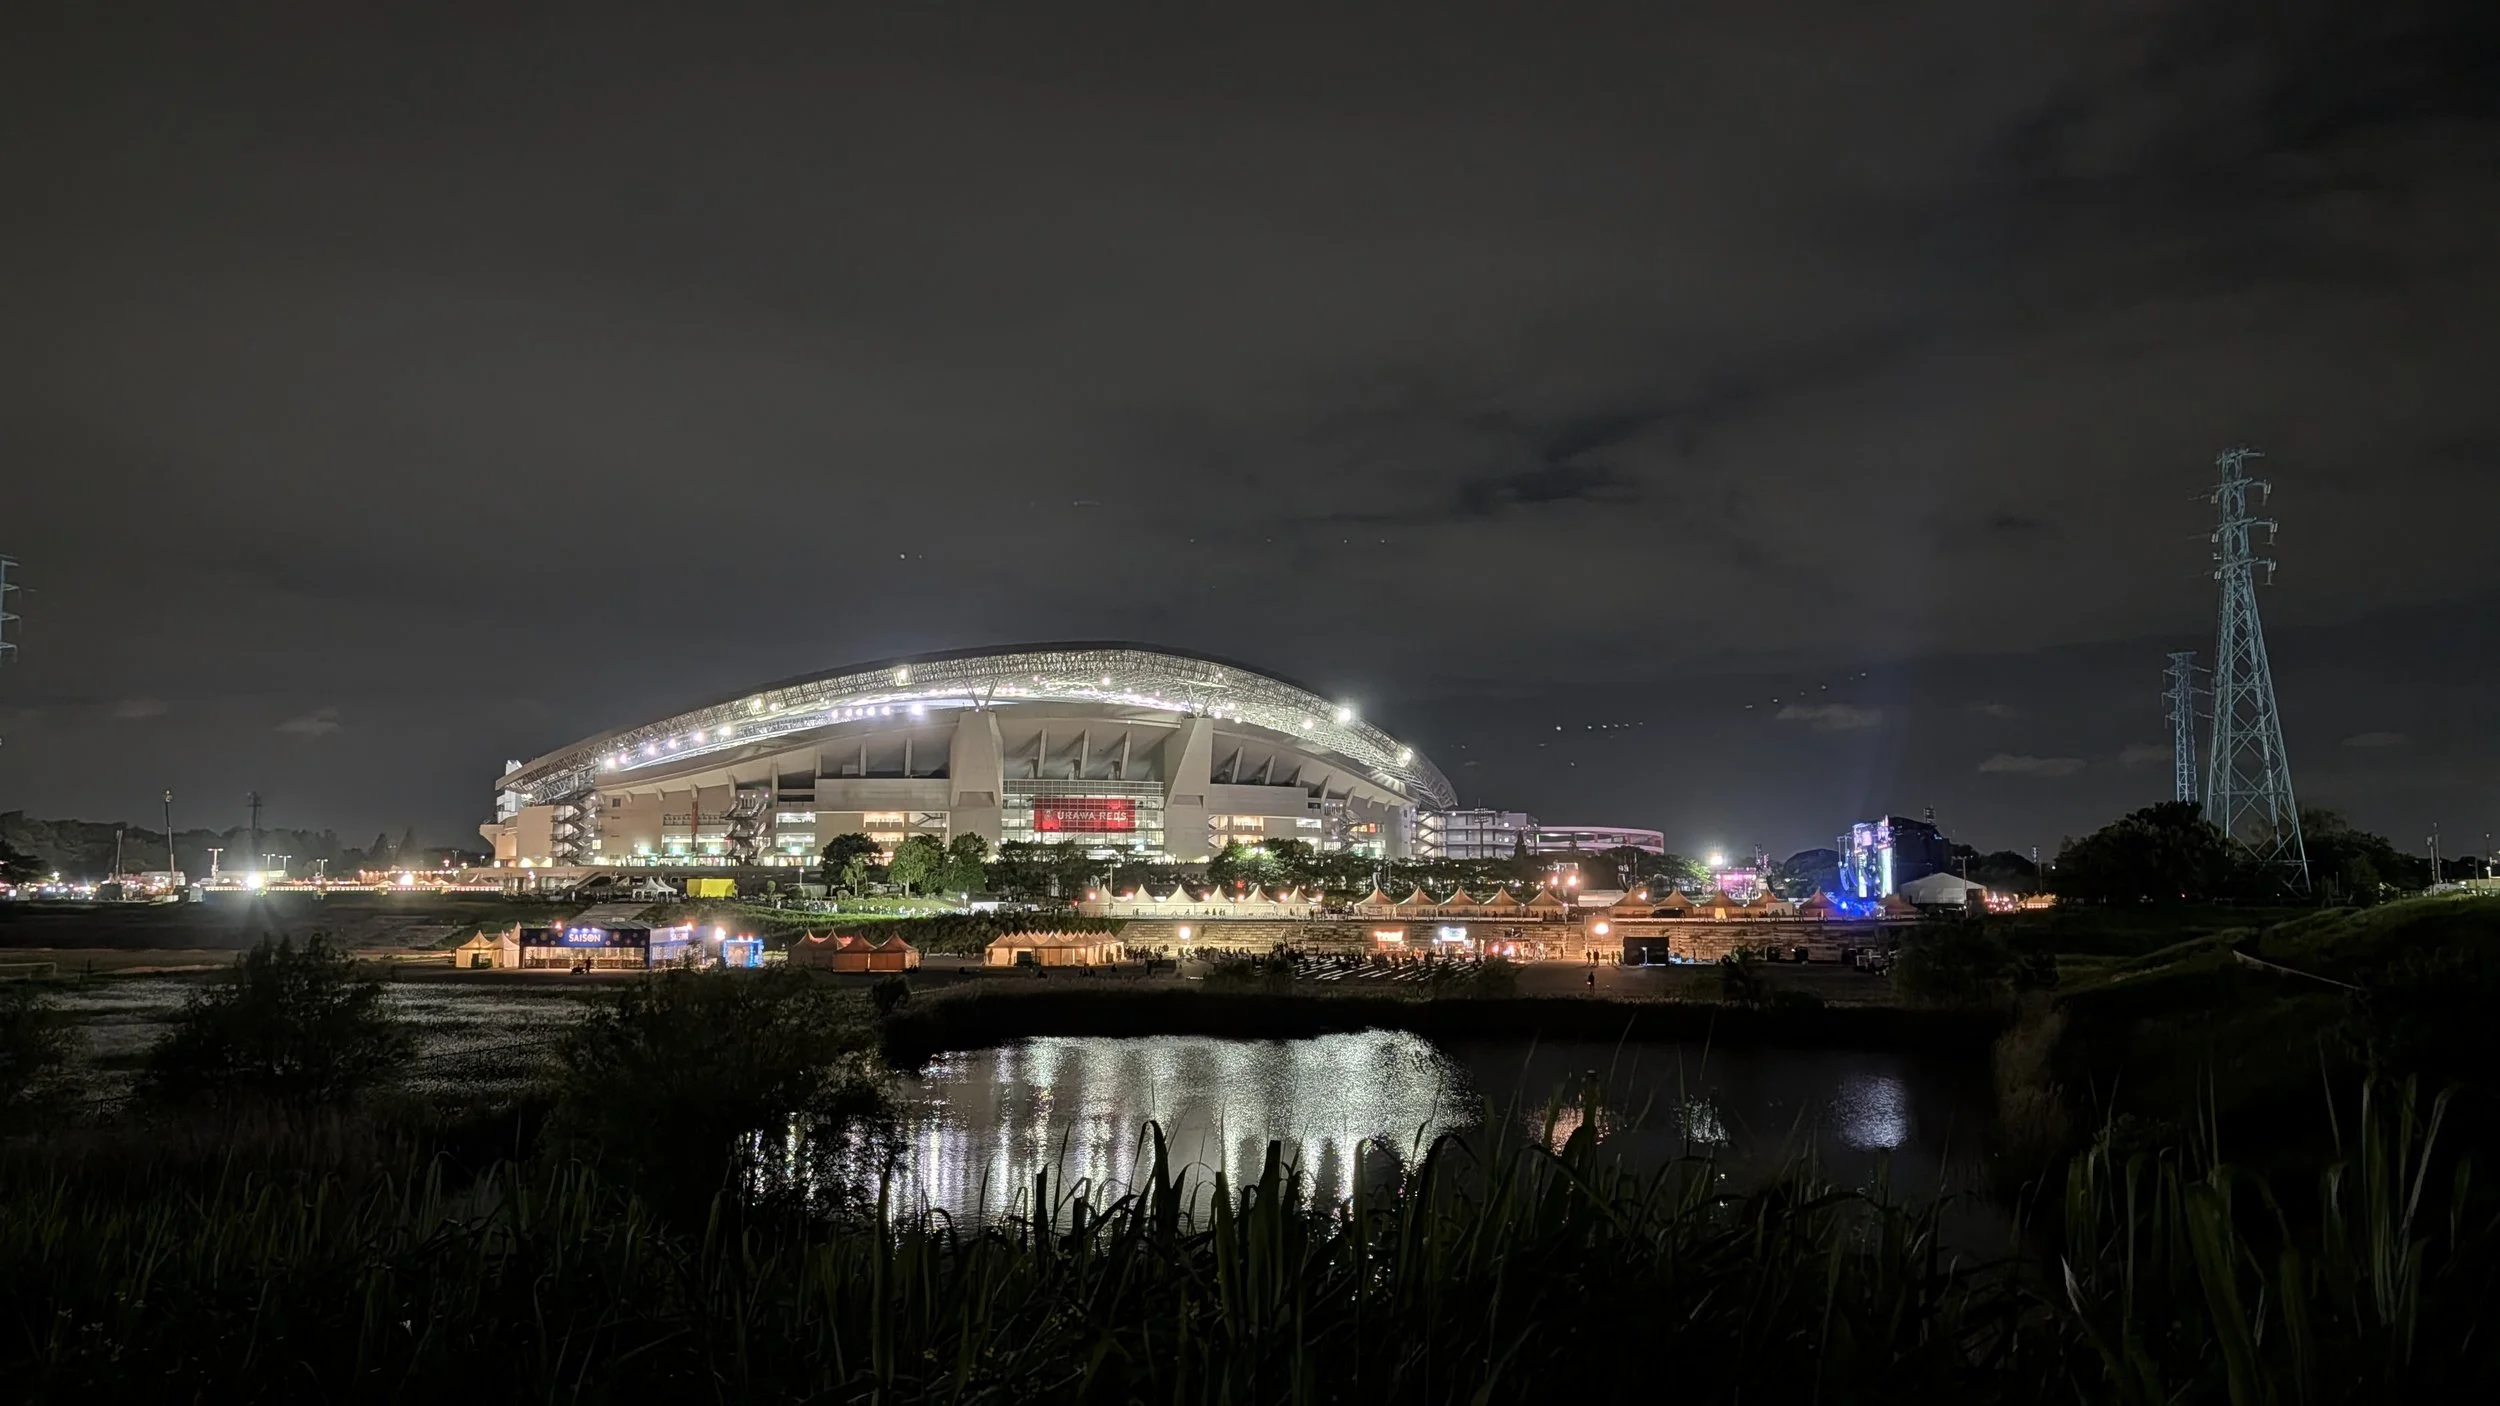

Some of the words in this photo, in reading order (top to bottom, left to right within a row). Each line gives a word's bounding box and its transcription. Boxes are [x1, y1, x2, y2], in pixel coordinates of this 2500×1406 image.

[1057, 811, 1096, 820] URAWA
[1099, 811, 1128, 821] REDS
[568, 933, 601, 943] SAISON
